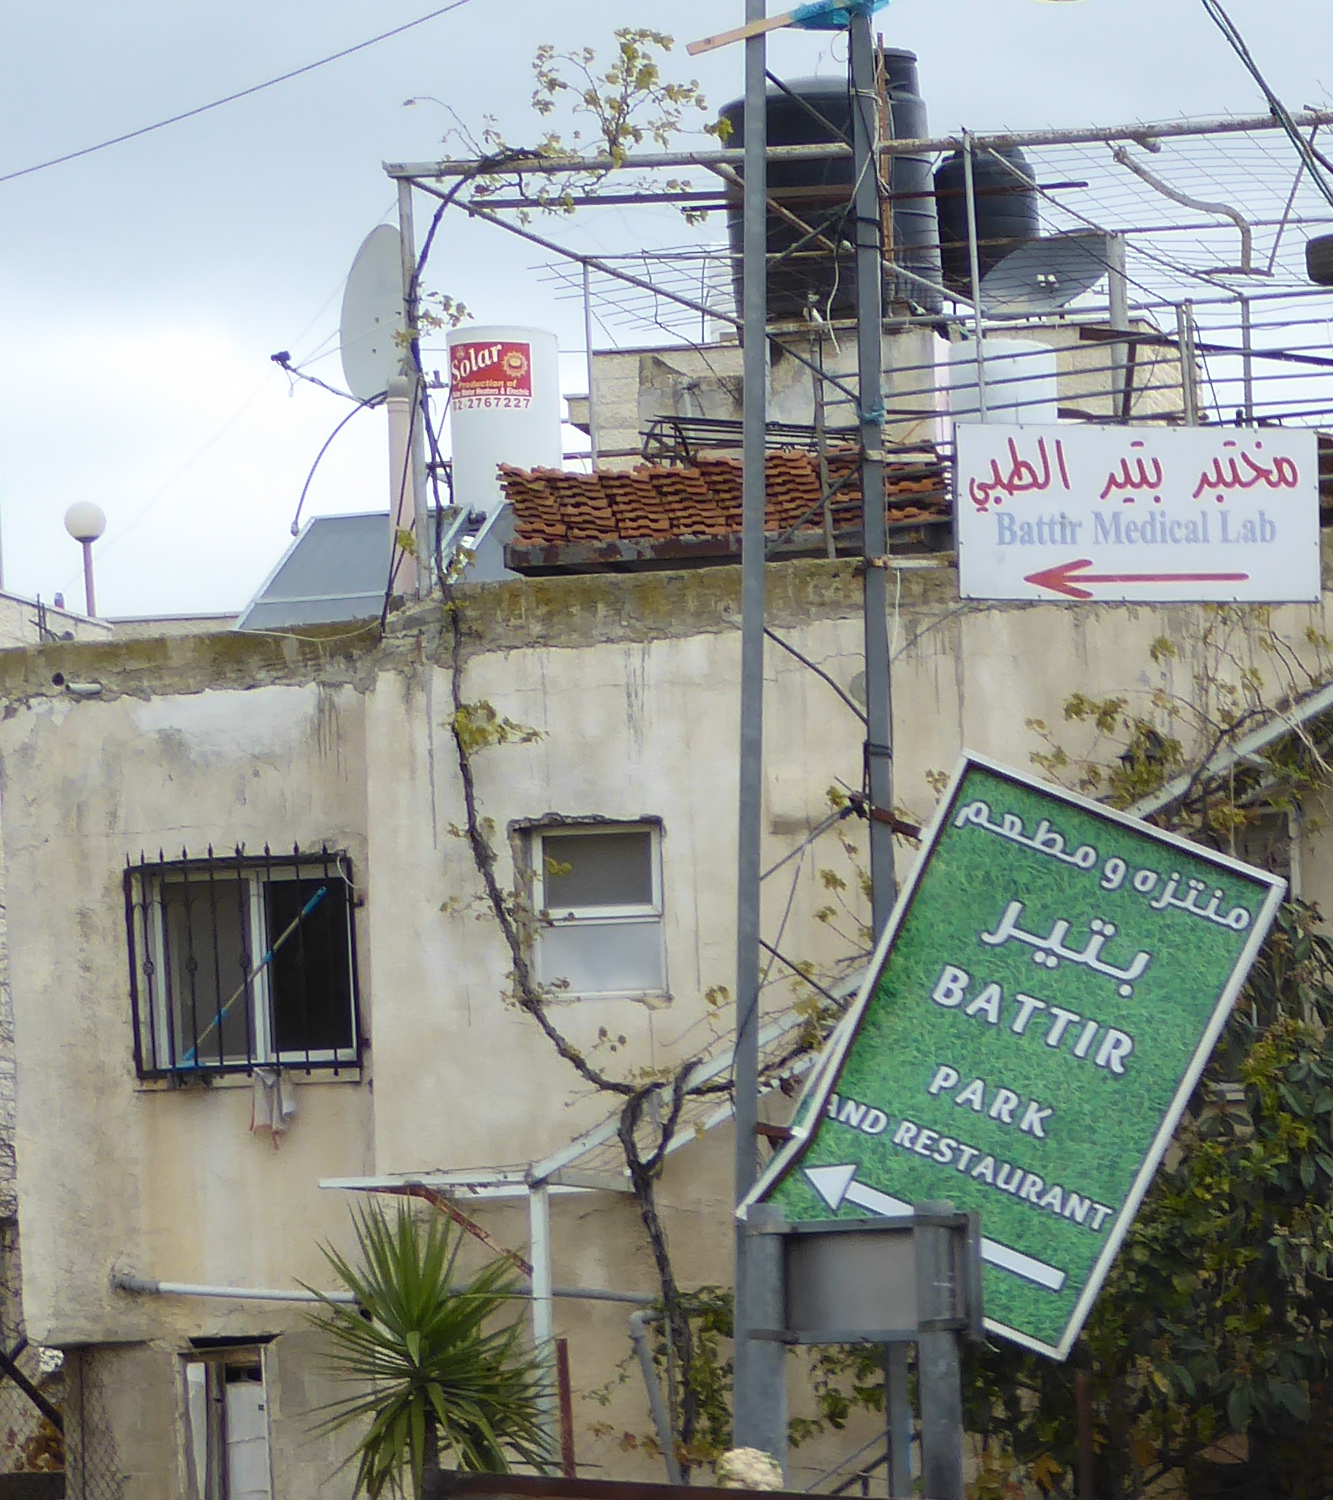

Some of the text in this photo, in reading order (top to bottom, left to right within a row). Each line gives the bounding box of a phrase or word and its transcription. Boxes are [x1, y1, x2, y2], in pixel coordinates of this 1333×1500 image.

[451, 344, 502, 385] Solar
[969, 436, 1299, 512] مختبر بتير الطبي
[995, 510, 1277, 546] Battir Medical Lab
[980, 900, 1151, 998] بتير
[932, 964, 1136, 1075] BATTIR
[927, 1065, 1054, 1139] PARK
[892, 1118, 1116, 1233] RESTAURANT
